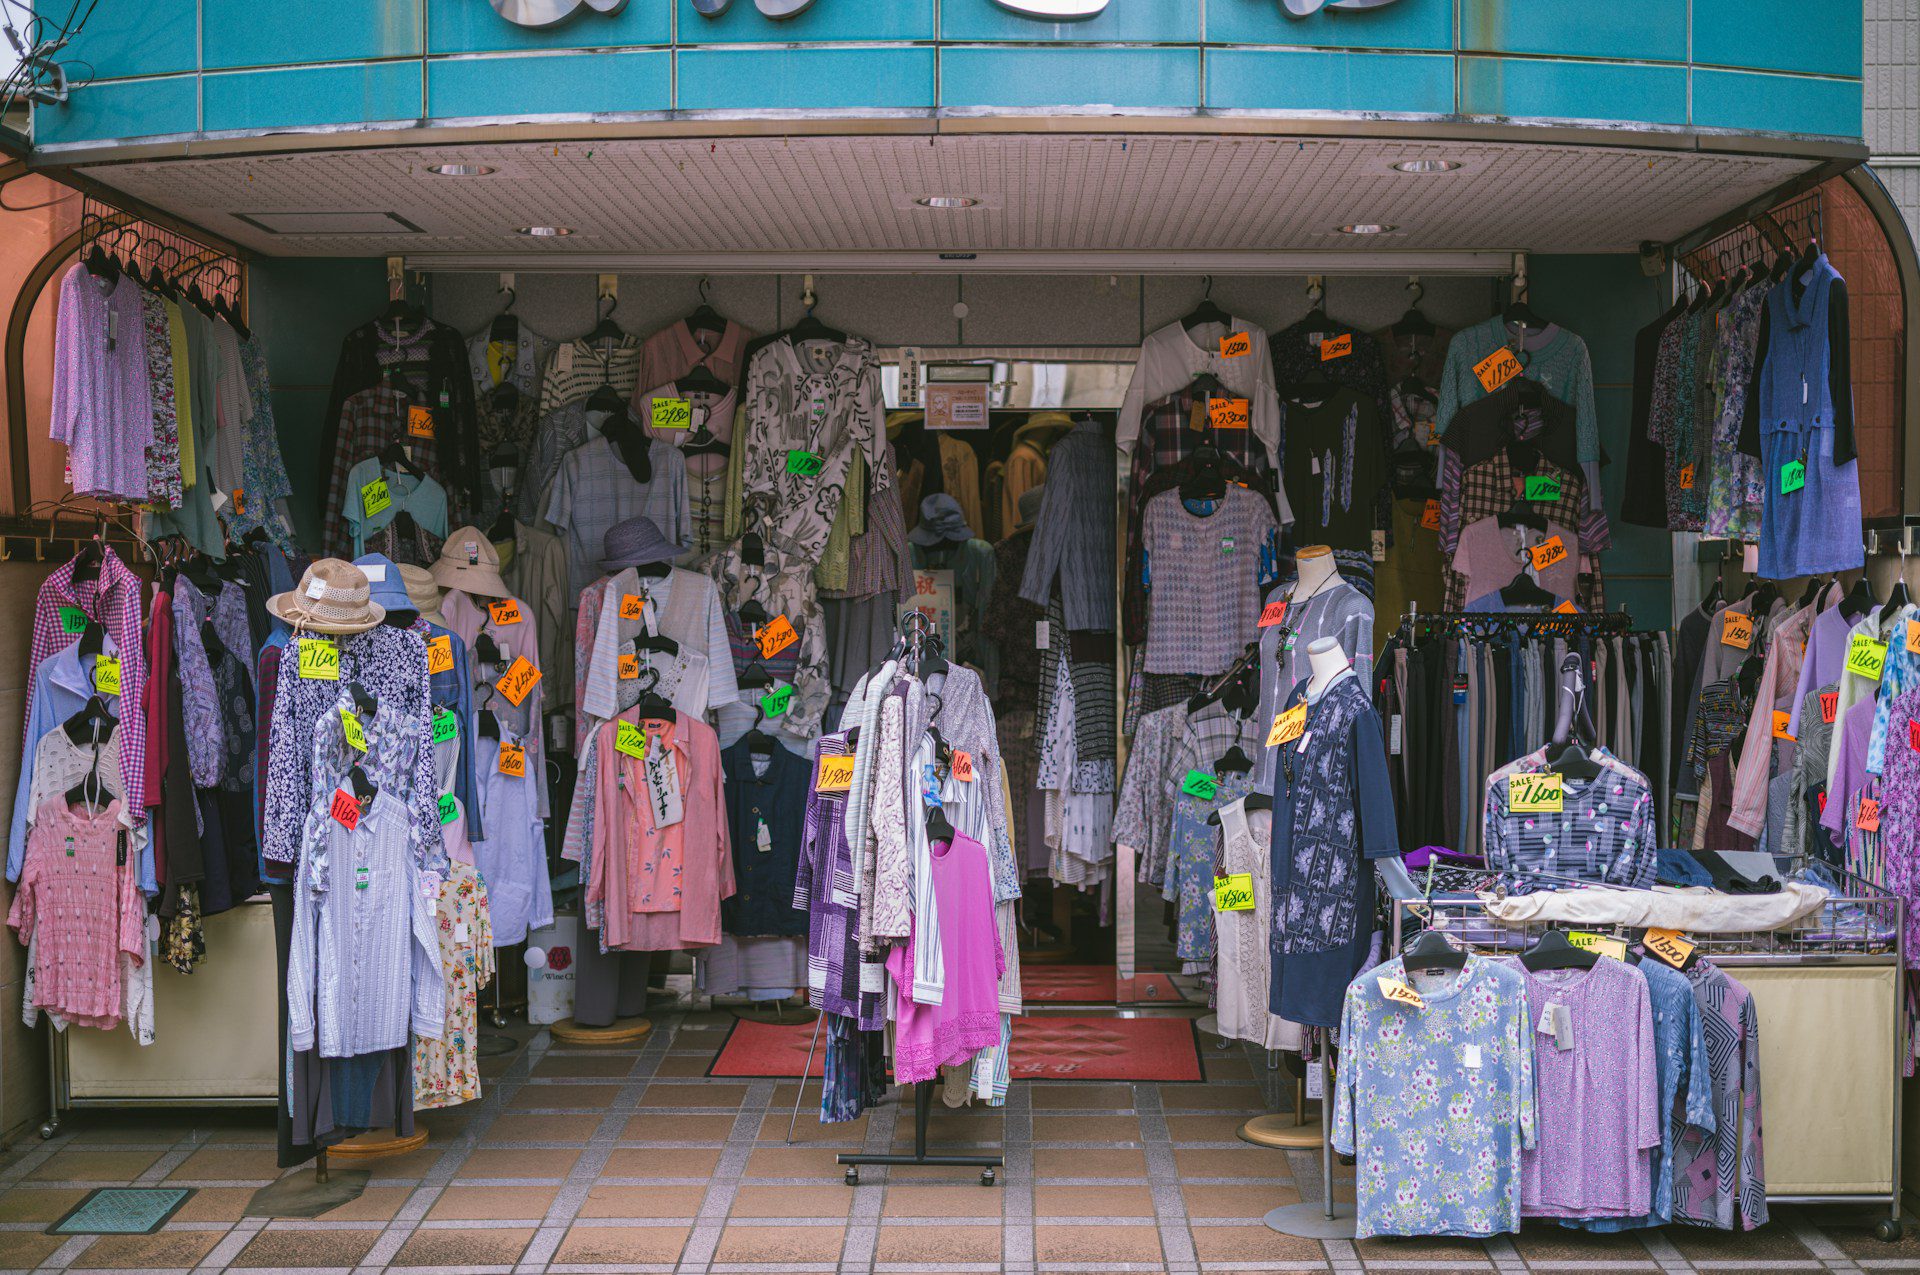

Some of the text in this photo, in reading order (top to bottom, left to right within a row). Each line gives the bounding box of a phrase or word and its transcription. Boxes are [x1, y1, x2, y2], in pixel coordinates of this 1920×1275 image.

[1477, 358, 1492, 377] SALE!
[653, 400, 672, 409] SALE!
[299, 642, 318, 653] SALE!
[1853, 638, 1872, 647] SALE!
[97, 658, 108, 668] SALE!
[502, 672, 513, 694] SALE!
[1273, 709, 1293, 728] SALE!
[1510, 774, 1537, 788] SALE!
[1215, 877, 1233, 889] SALE!
[1569, 937, 1598, 947] SALE!
